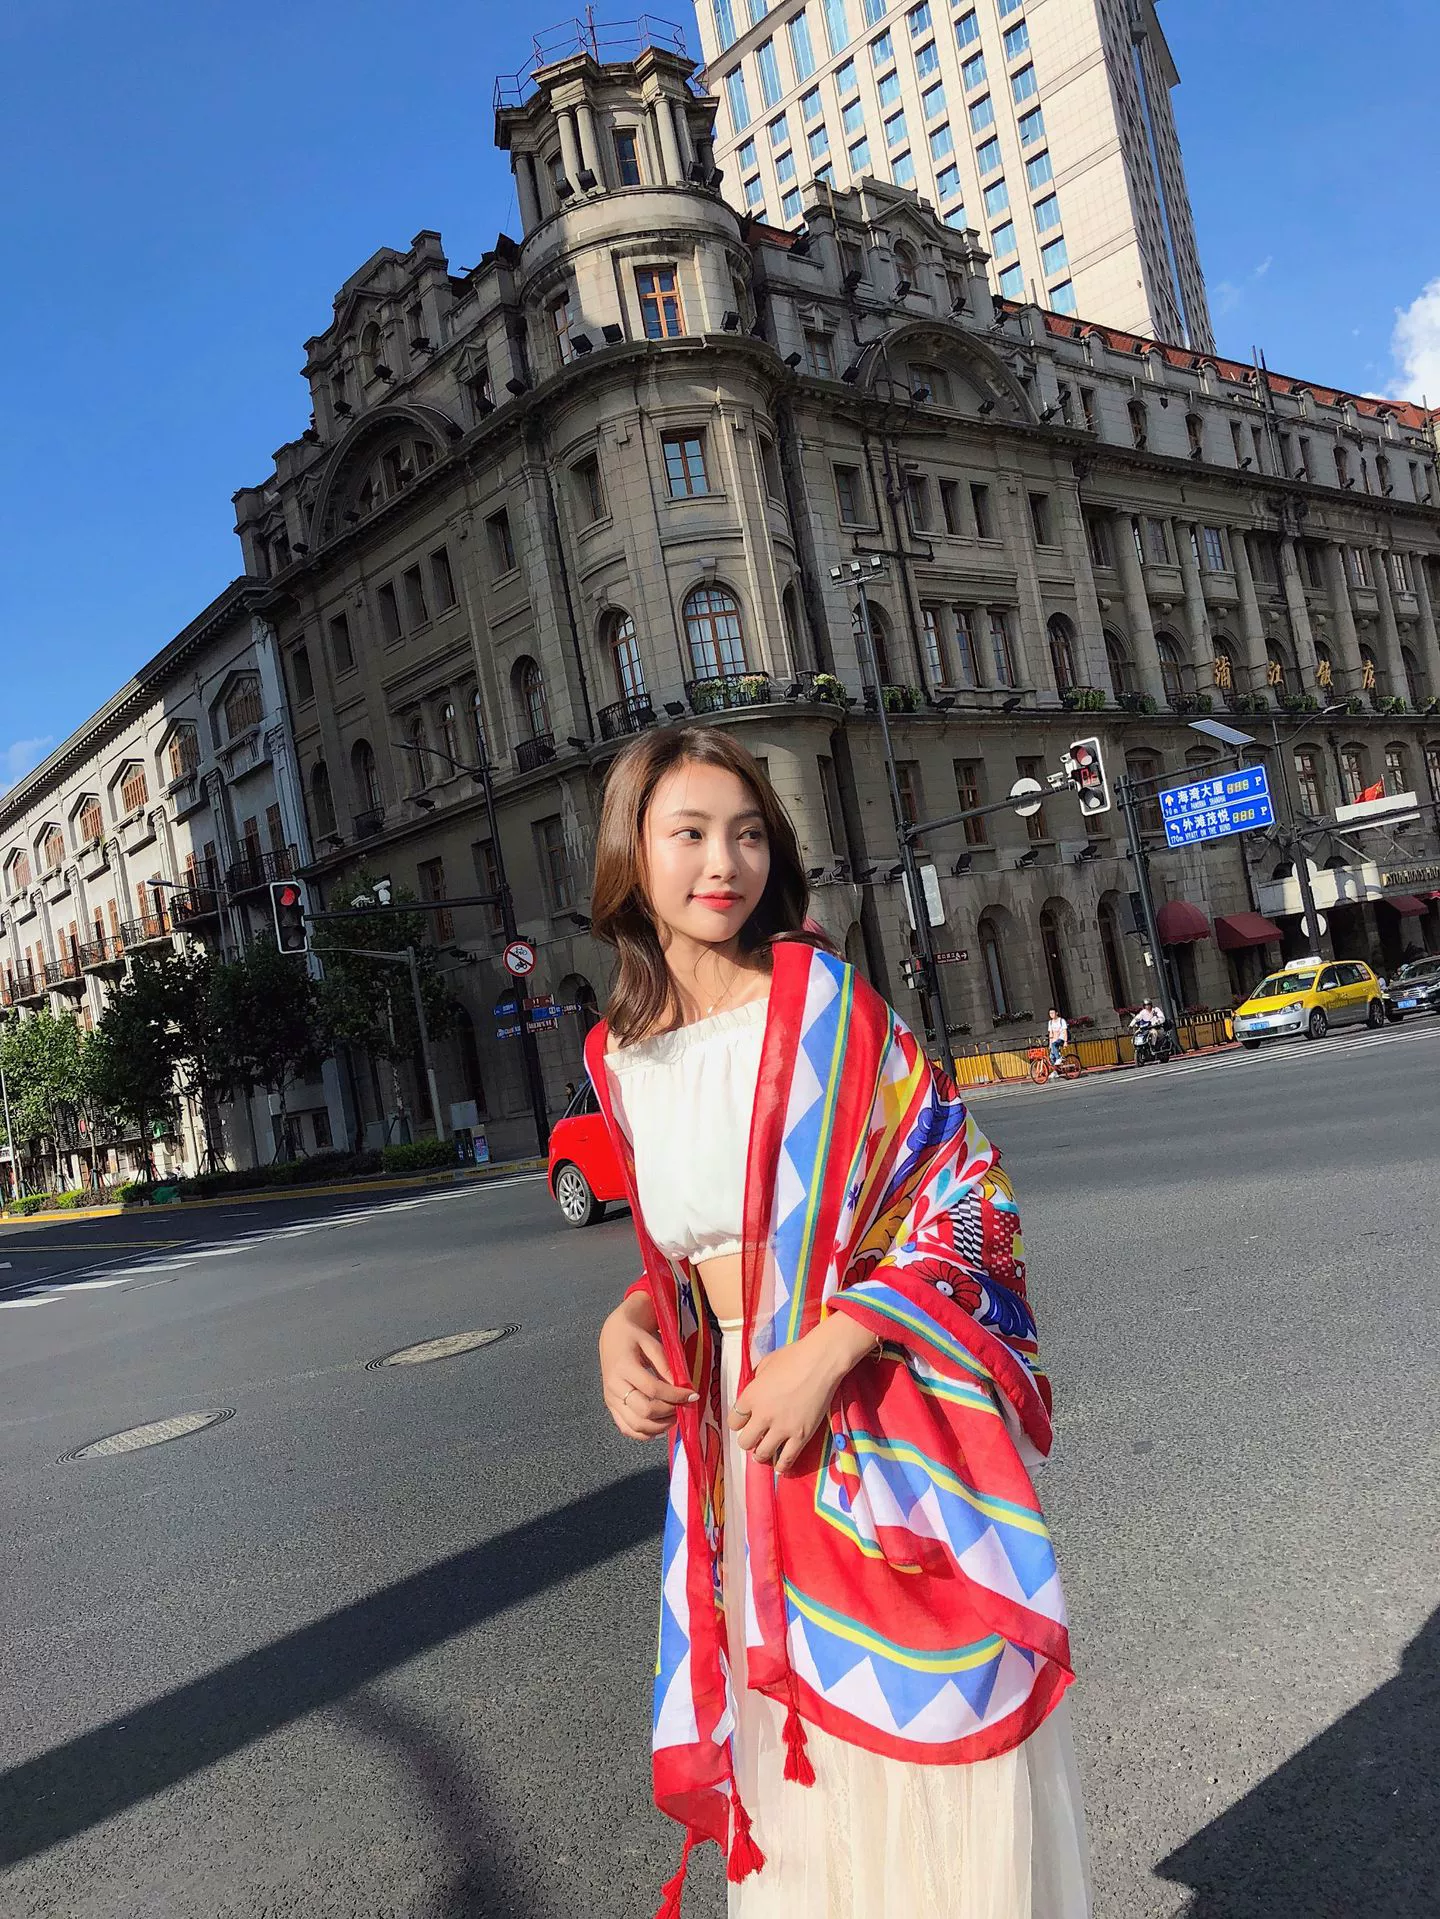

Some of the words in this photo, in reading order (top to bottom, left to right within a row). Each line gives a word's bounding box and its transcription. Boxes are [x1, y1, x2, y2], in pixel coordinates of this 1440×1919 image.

[1177, 781, 1224, 804] 海湾大厦
[1255, 776, 1262, 786] P
[1183, 808, 1230, 832] 外滩茂悦
[1260, 806, 1268, 816] P
